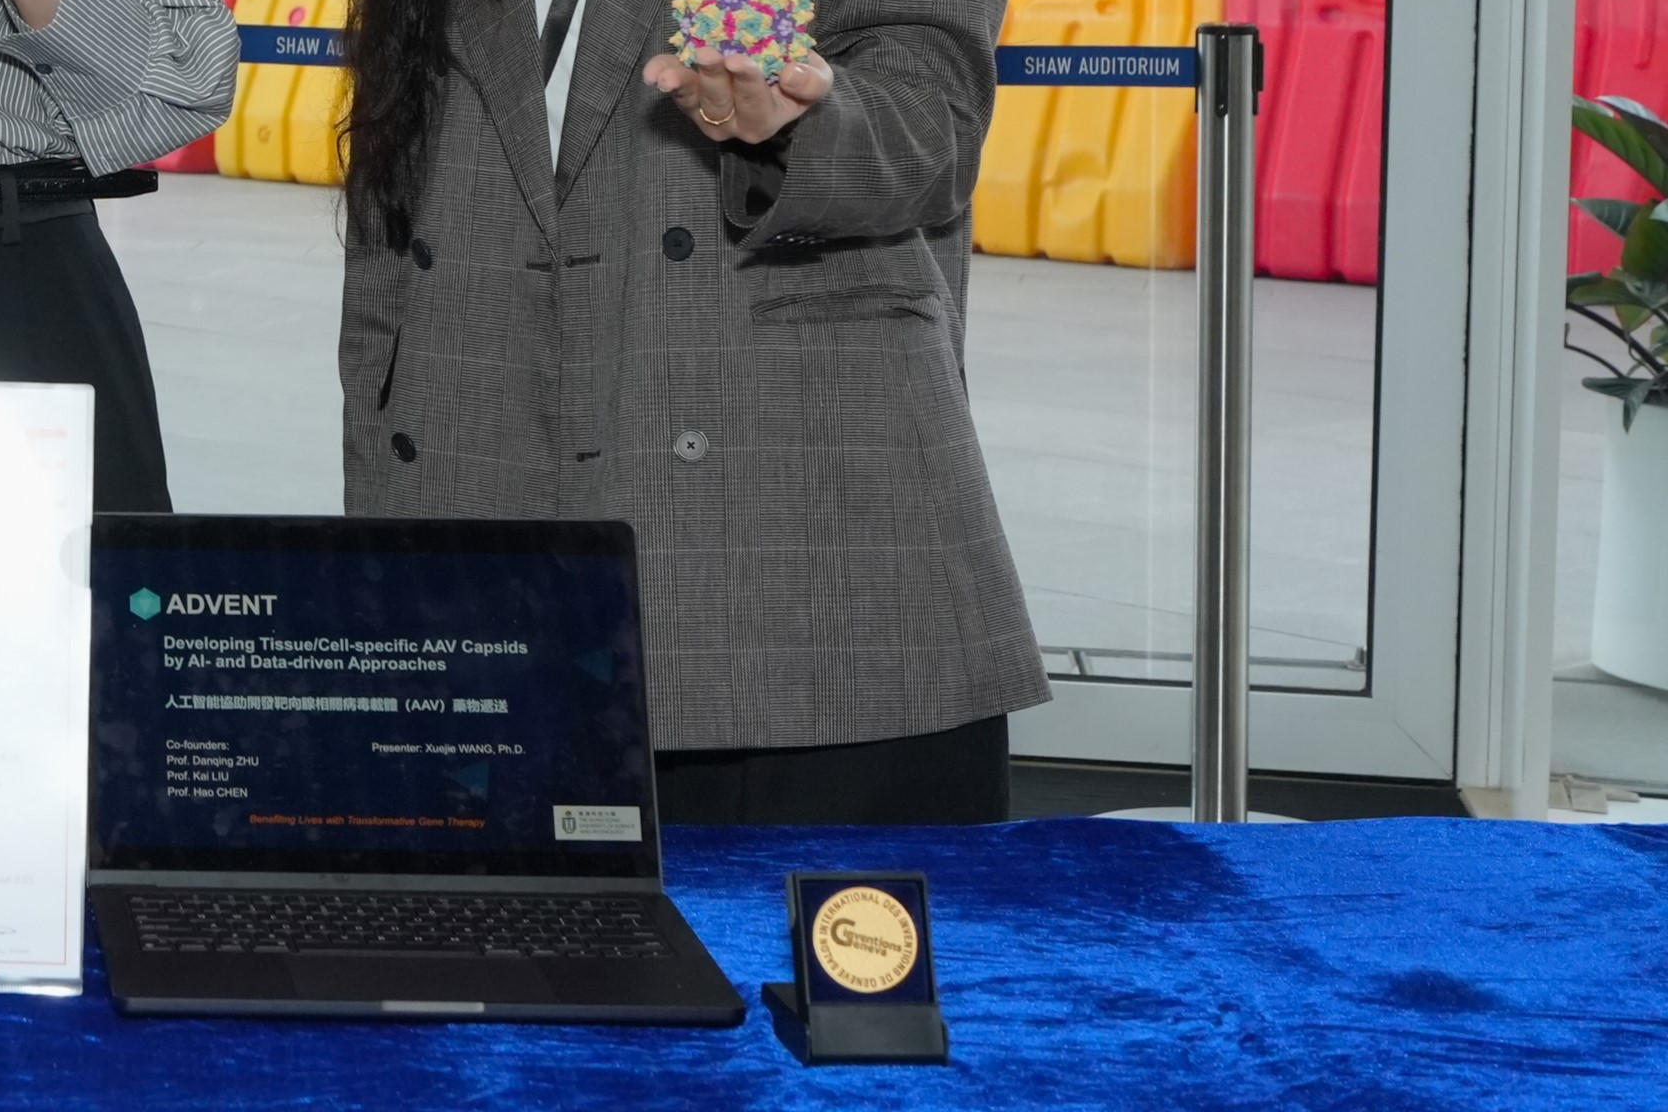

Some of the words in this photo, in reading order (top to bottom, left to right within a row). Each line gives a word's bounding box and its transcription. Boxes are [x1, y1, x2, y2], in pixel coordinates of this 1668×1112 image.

[276, 36, 320, 55] SHAW
[1024, 56, 1071, 75] SHAW
[1078, 56, 1179, 75] AUDITORIUM
[166, 593, 277, 615] ADVENT
[164, 635, 254, 656] Developing
[259, 636, 417, 658] Tissue/Cell-specific
[422, 638, 456, 653] AAV
[462, 639, 527, 656] Capsids
[164, 653, 184, 670] by
[187, 653, 211, 667] AI-
[215, 654, 245, 668] and
[250, 654, 344, 669] Data-driven
[347, 656, 446, 674] Approaches
[165, 739, 229, 750] Co-founders:
[371, 742, 422, 753] Presenter:
[425, 743, 456, 755] Xuejie
[458, 743, 495, 754] WANG,
[497, 744, 525, 754] Ph.D.
[166, 755, 189, 765] Prof.
[192, 755, 233, 768] Danqing
[236, 756, 258, 766] ZHU
[166, 770, 190, 780] Prof.
[192, 771, 209, 780] Kai
[211, 771, 228, 781] LIU
[168, 786, 190, 796] Prof.
[194, 787, 213, 797] Hao
[216, 787, 247, 797] CHEN
[250, 814, 296, 826] Benefiting
[298, 815, 323, 824] Lives
[326, 815, 344, 825] with
[348, 815, 415, 826] Transformative
[418, 816, 443, 826] Gene
[448, 816, 484, 828] Therapy
[819, 891, 880, 935] INTERNATIONAL
[883, 899, 902, 918] DES
